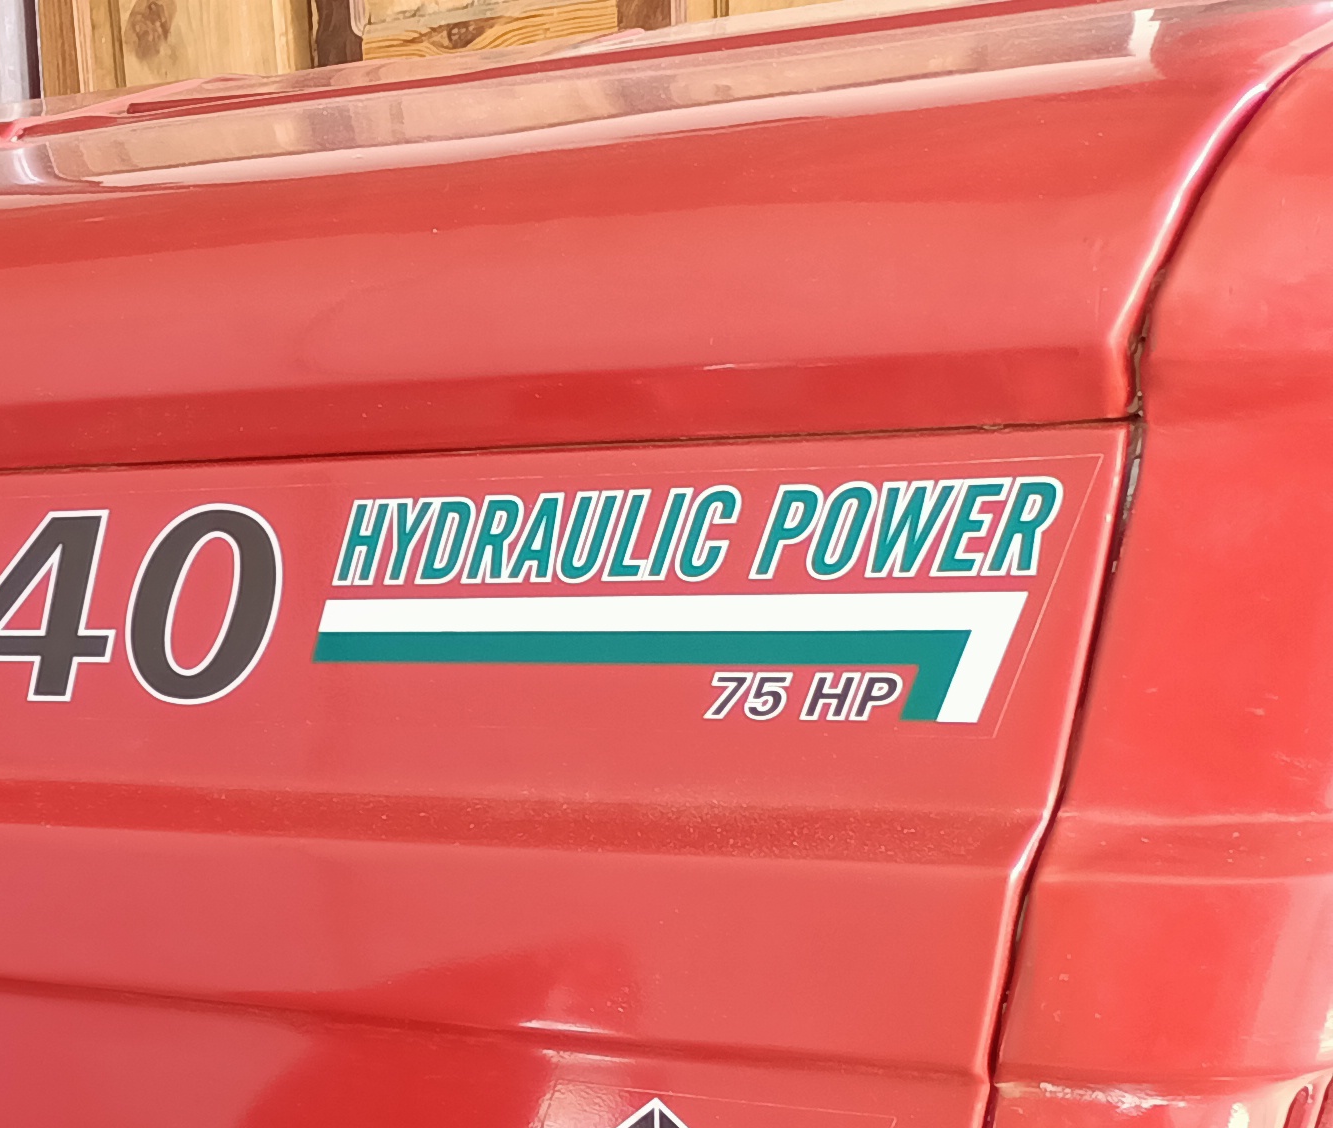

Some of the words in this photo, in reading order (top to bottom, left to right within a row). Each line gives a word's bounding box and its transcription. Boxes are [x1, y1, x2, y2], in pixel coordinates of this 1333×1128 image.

[333, 485, 742, 586] HYDRAULIC
[749, 475, 1064, 581] POWER
[704, 670, 794, 721] 75
[799, 670, 904, 722] HP
